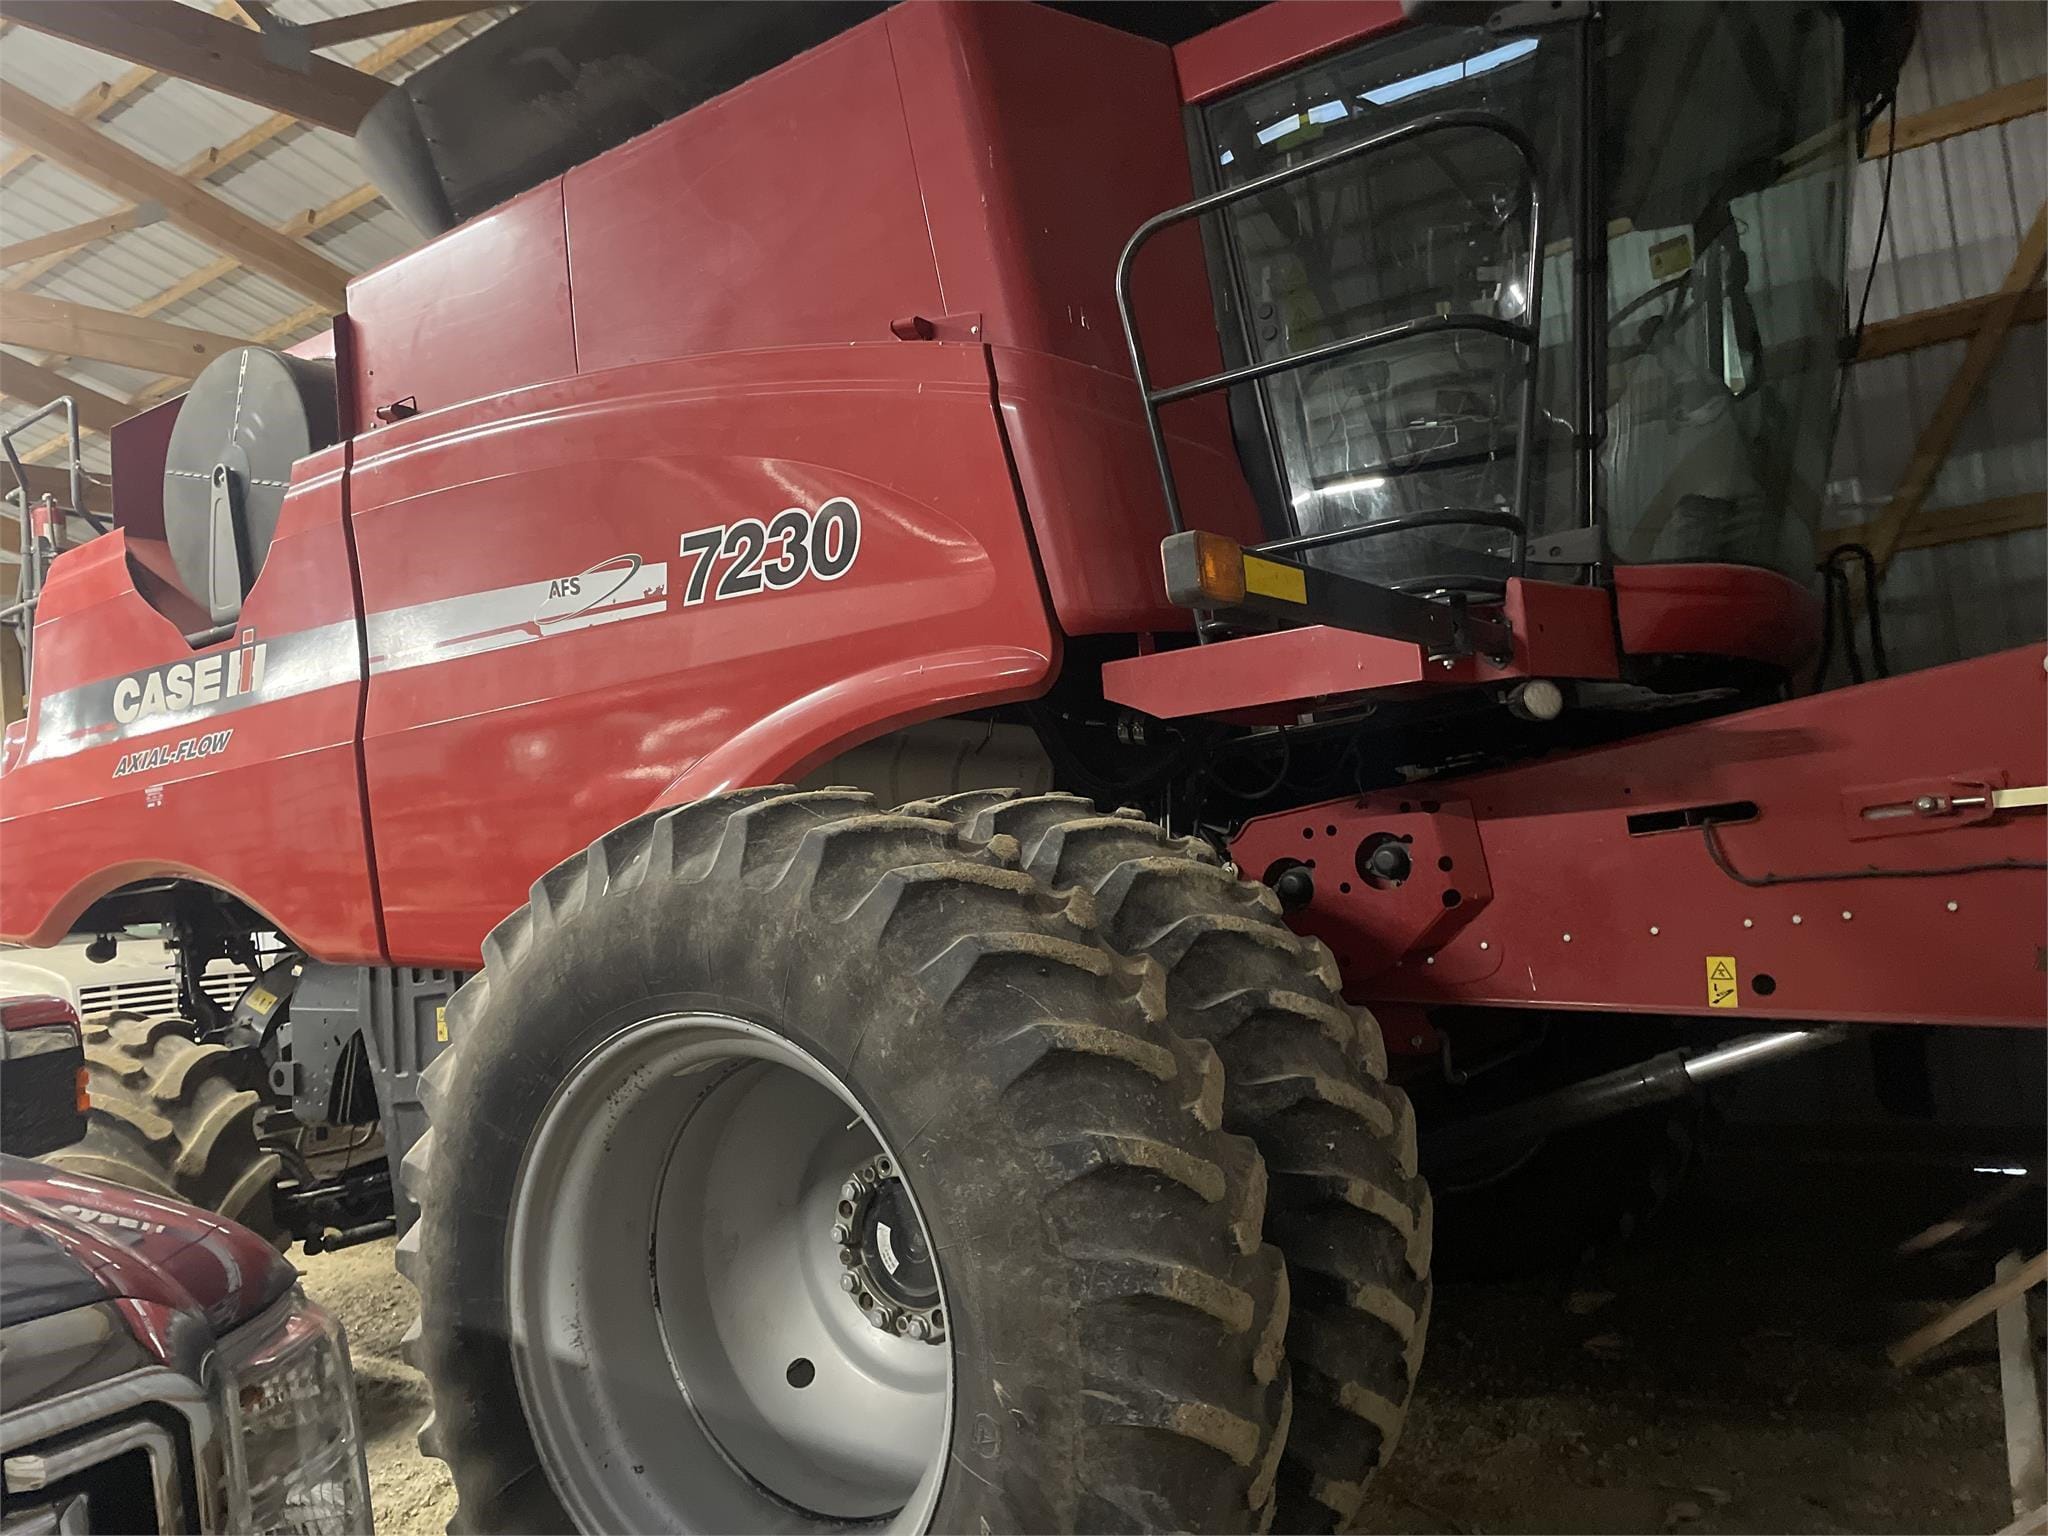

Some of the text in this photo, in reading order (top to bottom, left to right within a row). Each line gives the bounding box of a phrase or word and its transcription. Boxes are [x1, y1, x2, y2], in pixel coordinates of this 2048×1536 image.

[680, 497, 861, 607] 7230
[549, 577, 581, 599] AFS
[113, 655, 222, 724] CASE
[112, 728, 234, 779] AXIAL-FLOW
